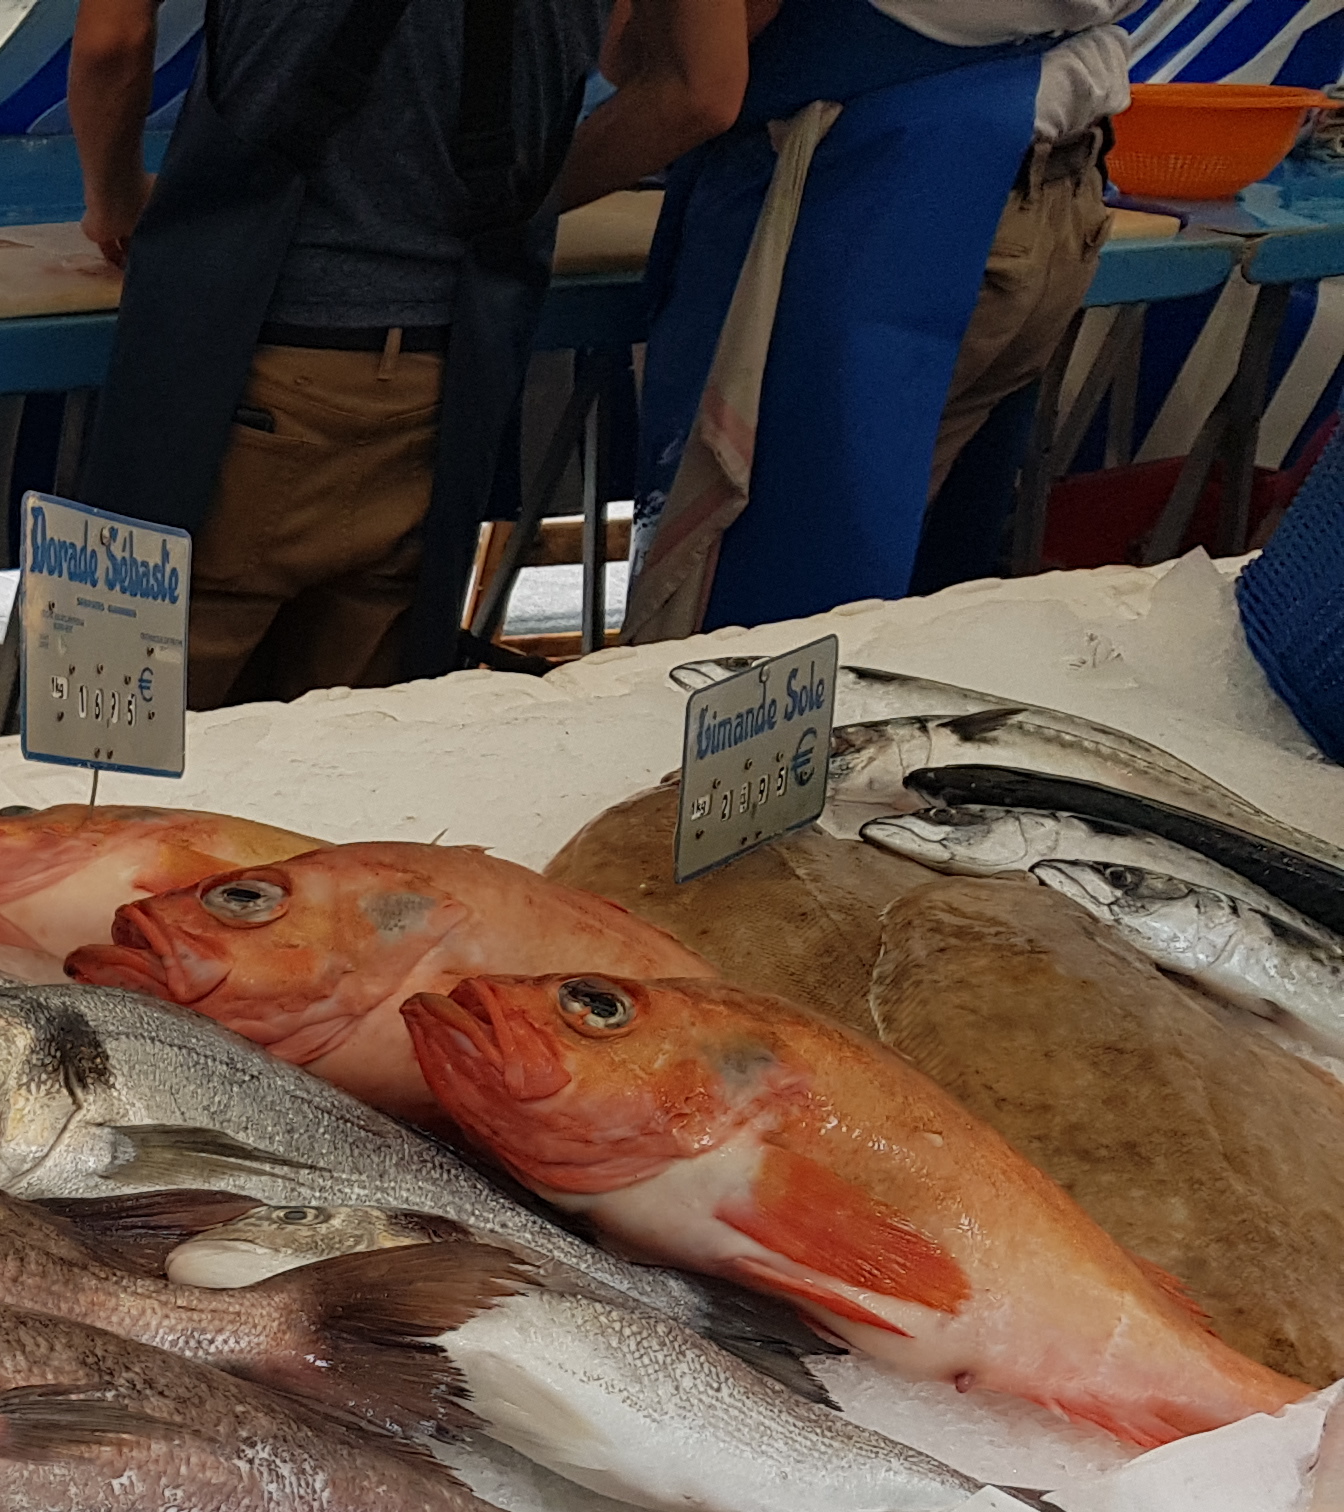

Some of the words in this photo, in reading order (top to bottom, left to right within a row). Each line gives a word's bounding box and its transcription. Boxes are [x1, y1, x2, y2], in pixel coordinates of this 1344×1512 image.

[30, 506, 99, 588] Dorade
[105, 526, 179, 604] Sébaste
[138, 667, 153, 702] €
[696, 680, 777, 760] Limande
[784, 661, 825, 721] Sole
[791, 727, 817, 786] €
